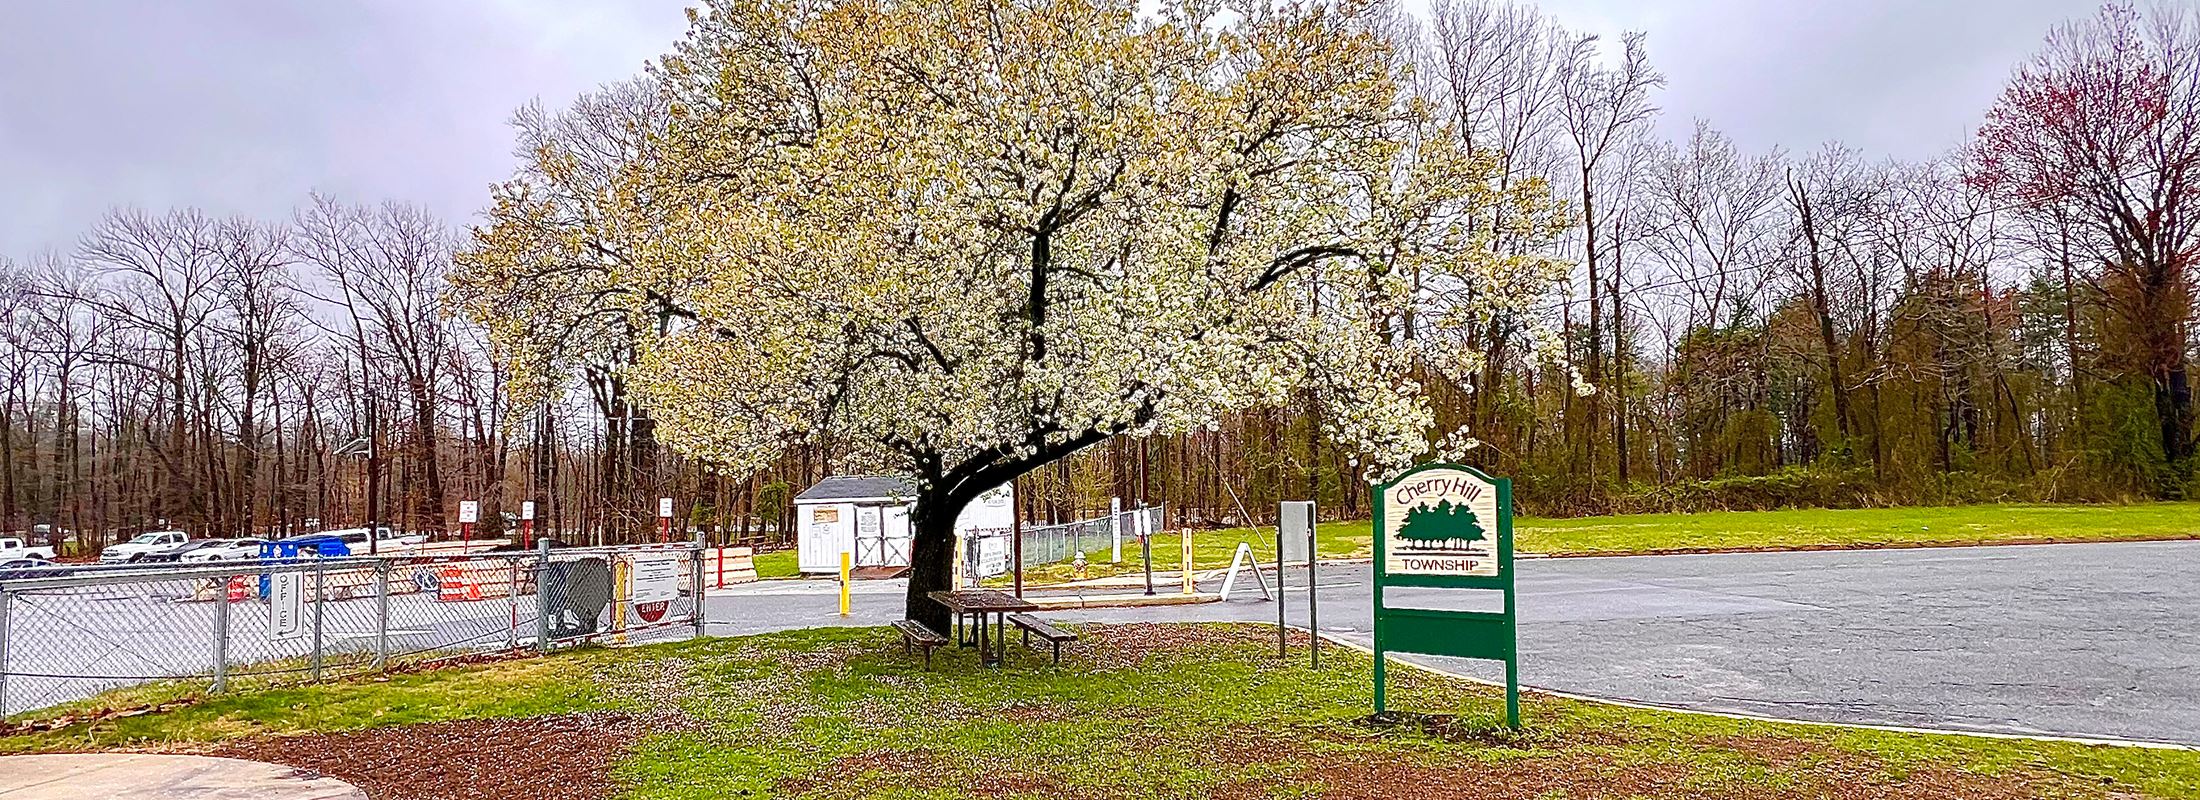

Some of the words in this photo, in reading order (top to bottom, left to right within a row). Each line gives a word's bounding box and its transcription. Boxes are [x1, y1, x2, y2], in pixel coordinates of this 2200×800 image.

[1396, 478, 1452, 505] Cherry
[1452, 477, 1482, 503] Hill
[1402, 559, 1479, 571] TOWNSHIP
[279, 574, 289, 627] OFFICE
[641, 602, 665, 613] ENTER
